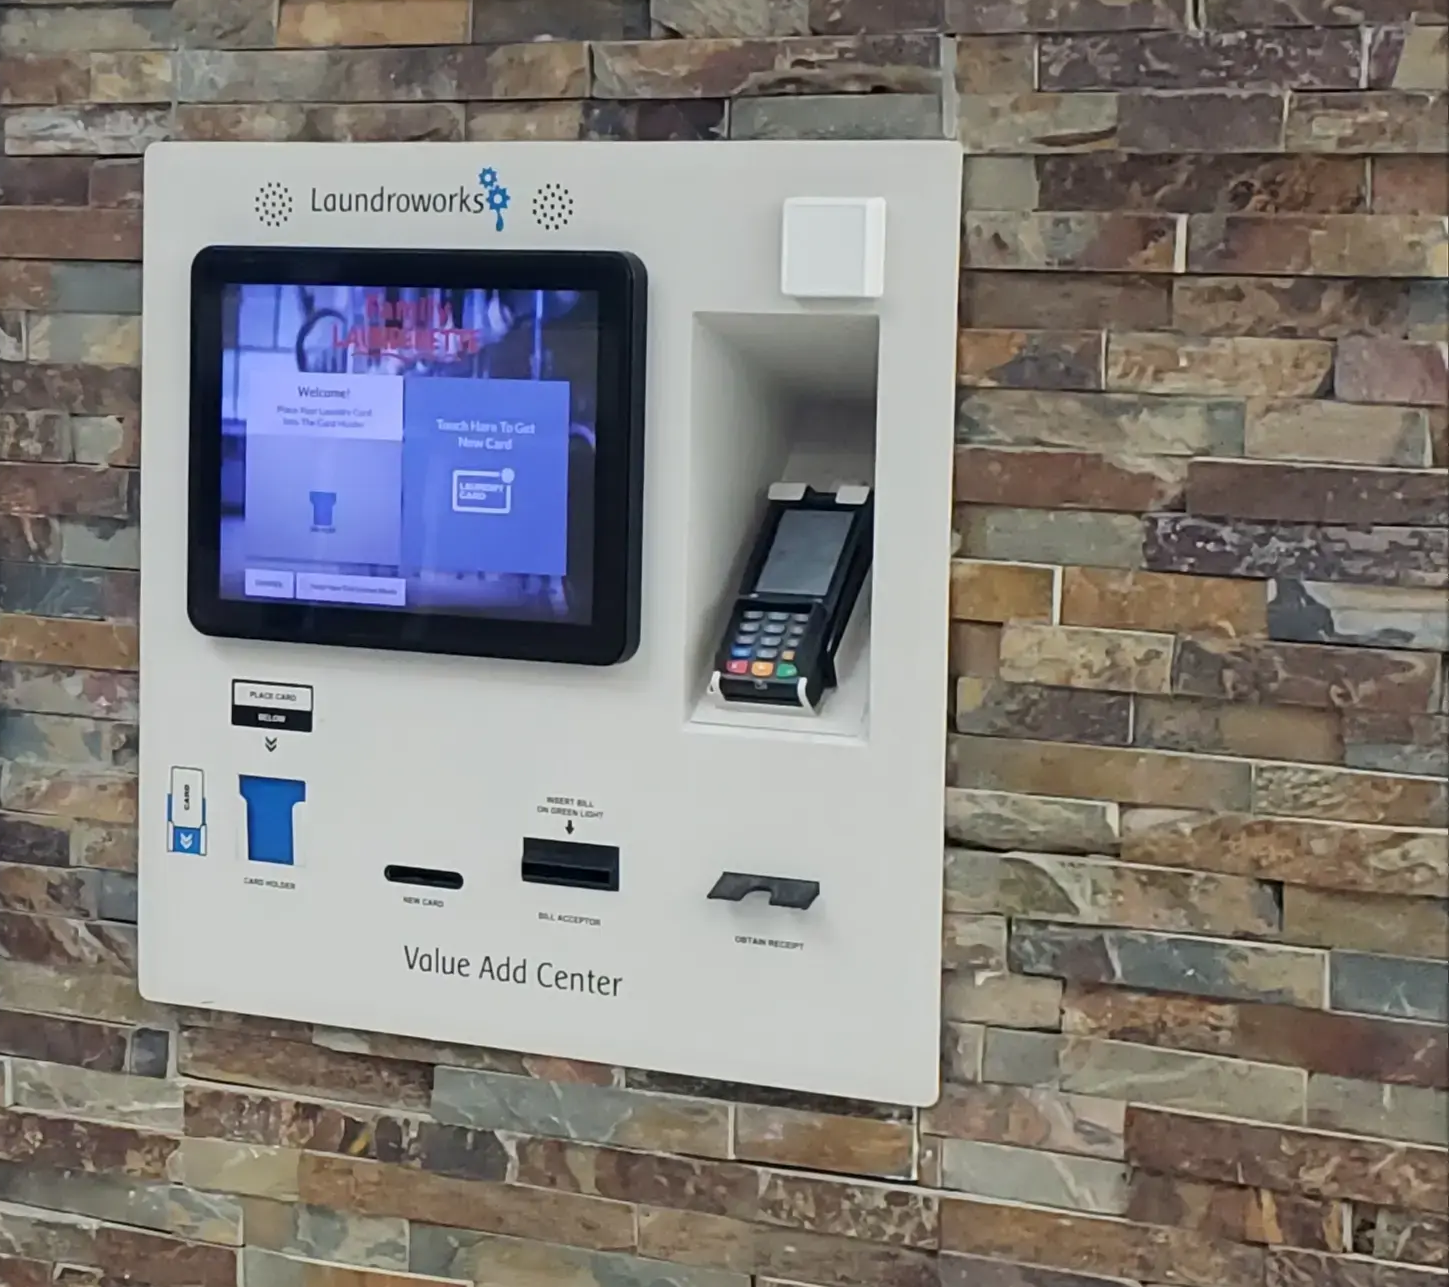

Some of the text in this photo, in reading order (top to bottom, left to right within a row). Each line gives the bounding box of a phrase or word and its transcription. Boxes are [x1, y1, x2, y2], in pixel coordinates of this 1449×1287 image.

[310, 185, 485, 214] Laundroworks
[297, 385, 351, 399] Welcome!
[499, 421, 514, 433] To
[485, 437, 513, 450] Card
[249, 690, 297, 702] PLACE CARD
[243, 877, 296, 890] CARD HOLDER
[403, 896, 444, 908] NEW CARD
[557, 914, 601, 926] ACCEPTOR
[734, 935, 767, 946] OBTAIN
[403, 945, 624, 997] Value Add Center
